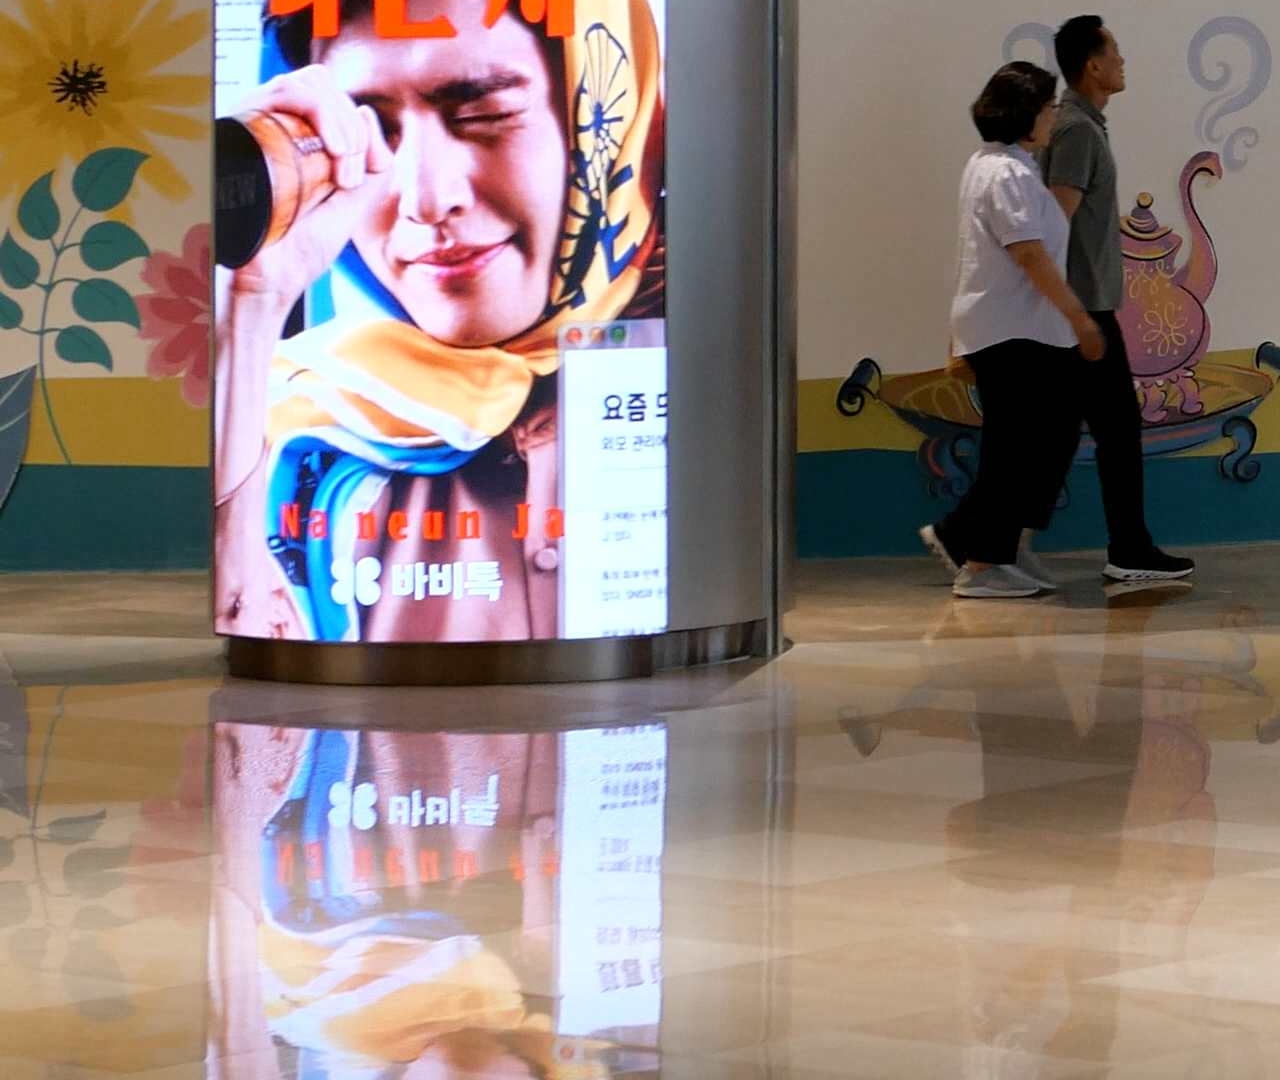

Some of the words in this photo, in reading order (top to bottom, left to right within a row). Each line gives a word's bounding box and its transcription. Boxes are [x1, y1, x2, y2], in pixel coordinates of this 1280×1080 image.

[601, 393, 648, 422] 요즘
[280, 502, 328, 539] Na
[355, 506, 481, 541] neun
[391, 559, 504, 602] 바비톡
